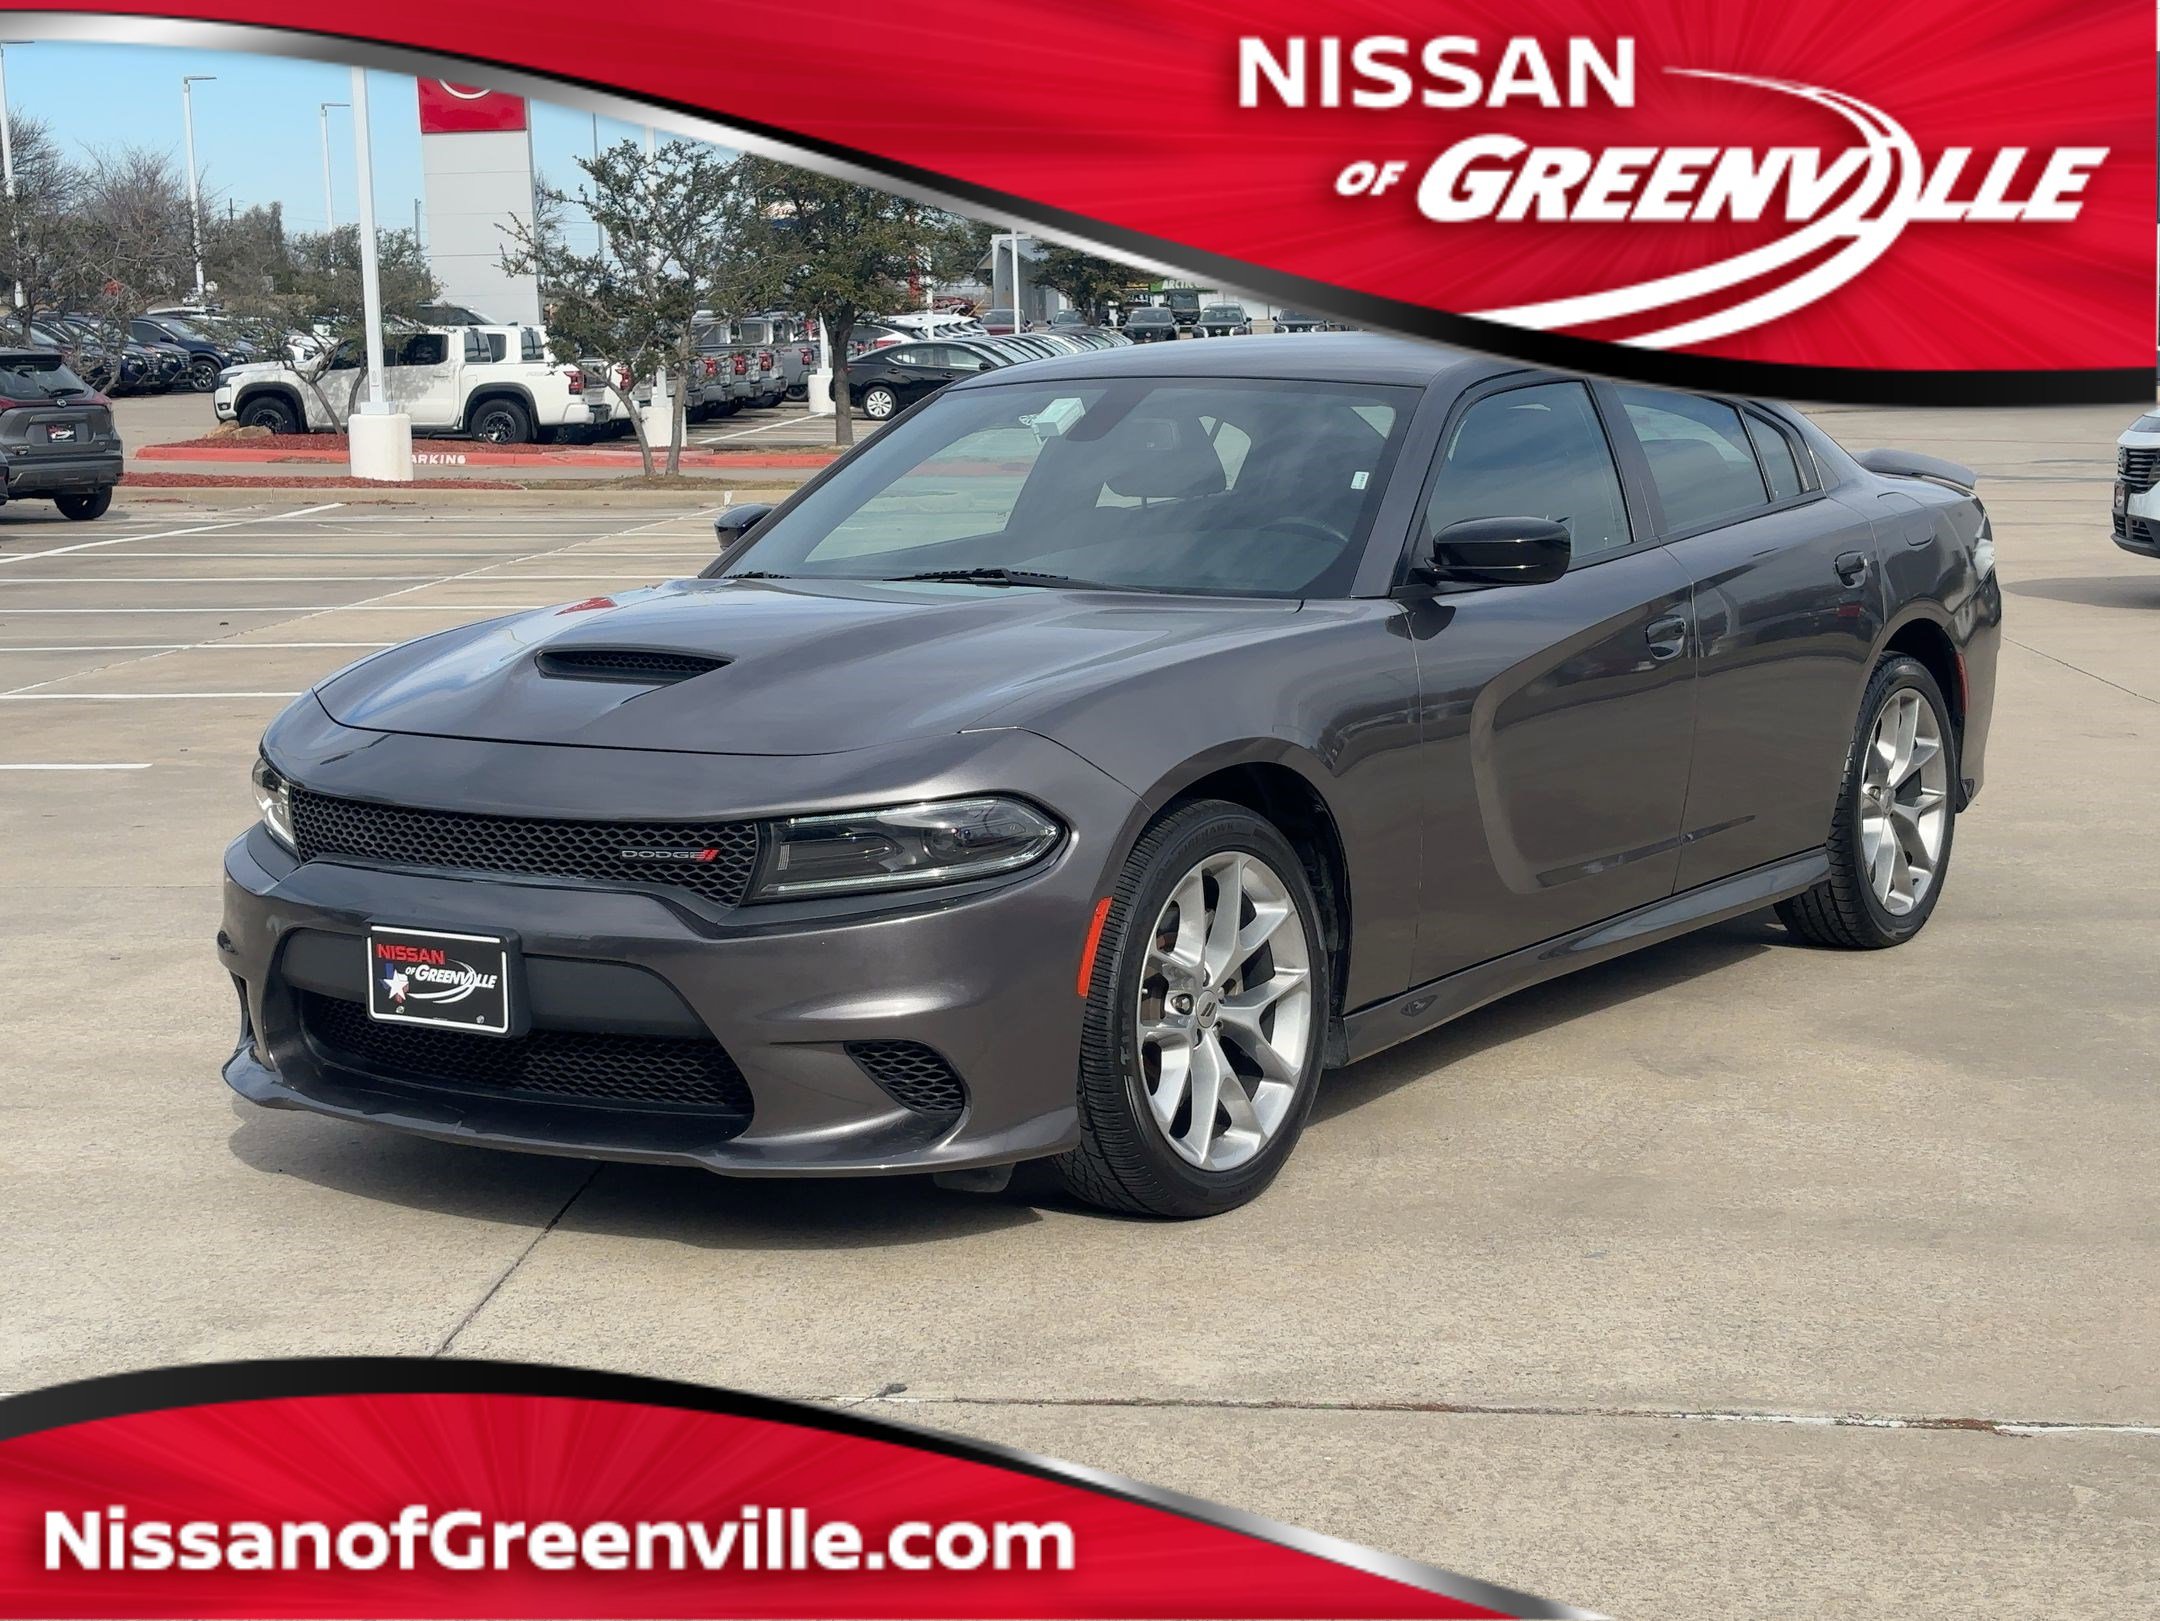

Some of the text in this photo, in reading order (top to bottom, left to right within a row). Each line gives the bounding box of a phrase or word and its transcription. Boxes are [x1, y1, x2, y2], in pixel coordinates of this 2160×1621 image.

[411, 454, 466, 465] ARKING
[621, 849, 706, 859] DODGE
[376, 943, 446, 965] NISSAN
[405, 964, 497, 989] OF GREENVILLE
